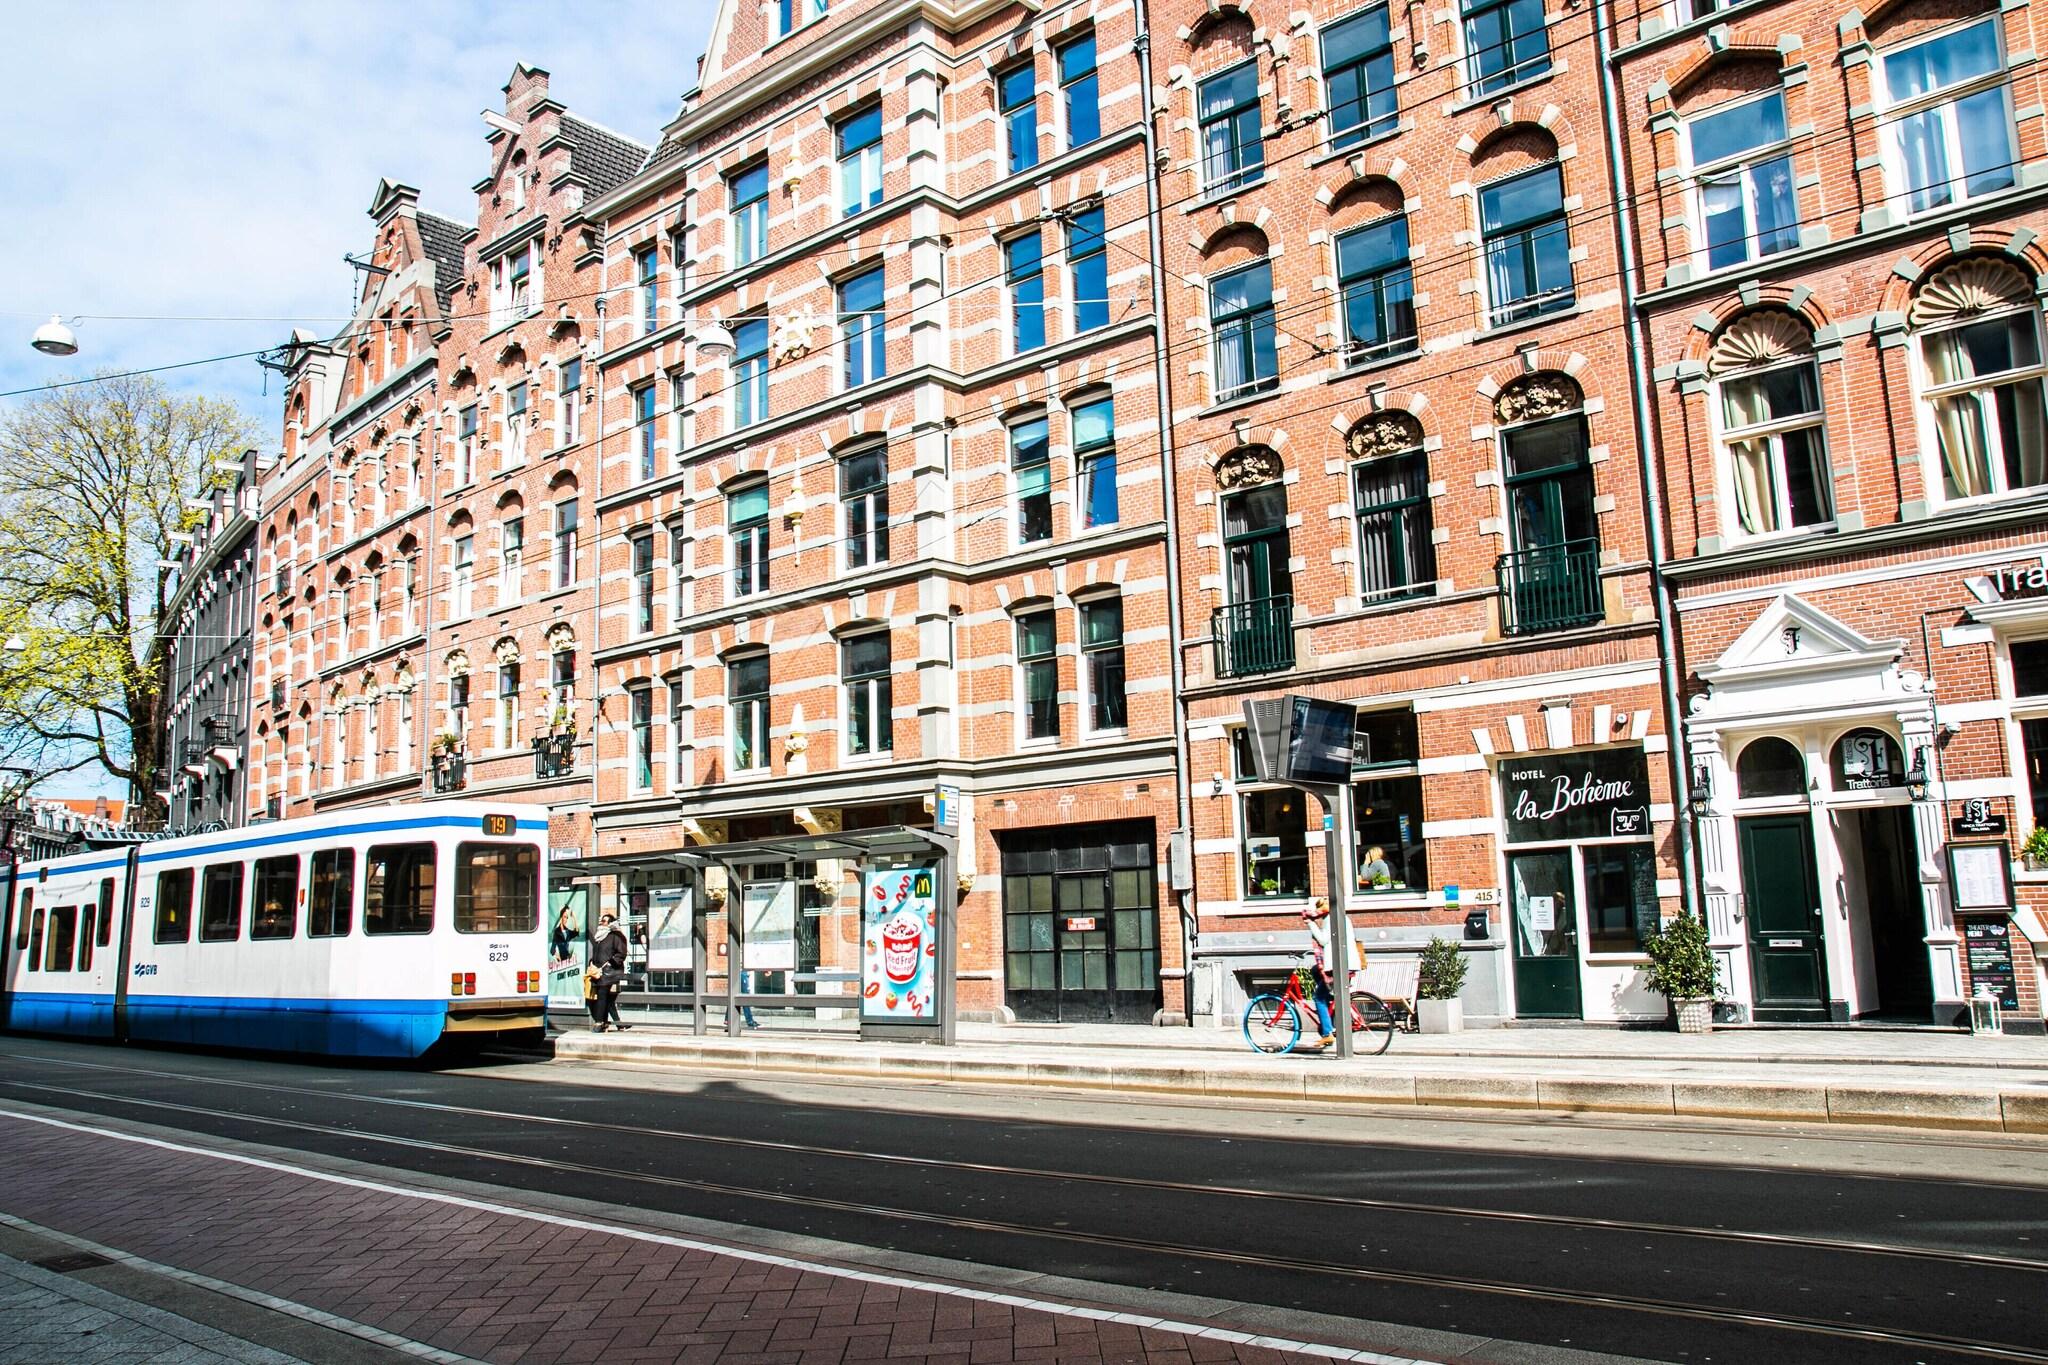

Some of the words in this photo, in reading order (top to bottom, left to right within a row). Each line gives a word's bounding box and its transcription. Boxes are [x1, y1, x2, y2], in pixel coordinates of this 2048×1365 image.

[1512, 770, 1545, 780] HOTEL
[1846, 778, 1890, 790] Trattoria
[1512, 790, 1539, 820] la
[1540, 772, 1634, 819] Bohème
[490, 816, 506, 834] 19
[1475, 891, 1493, 901] 415
[140, 897, 150, 908] 829
[489, 952, 509, 962] 829
[145, 964, 158, 976] GVB
